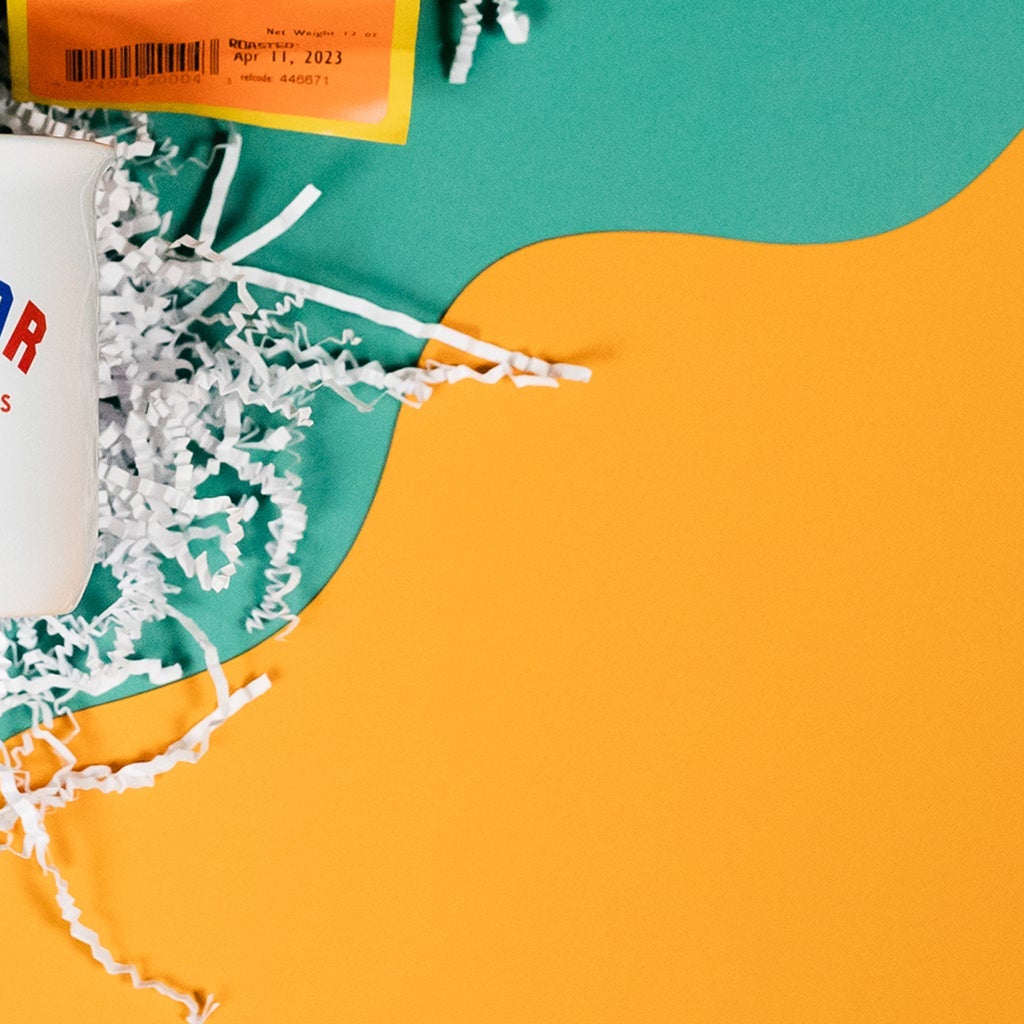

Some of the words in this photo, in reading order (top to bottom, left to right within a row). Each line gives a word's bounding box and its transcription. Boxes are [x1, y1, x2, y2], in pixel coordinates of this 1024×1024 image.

[266, 28, 286, 36] Net
[233, 52, 259, 66] Apr
[272, 51, 294, 65] 11,
[304, 50, 343, 65] 2023
